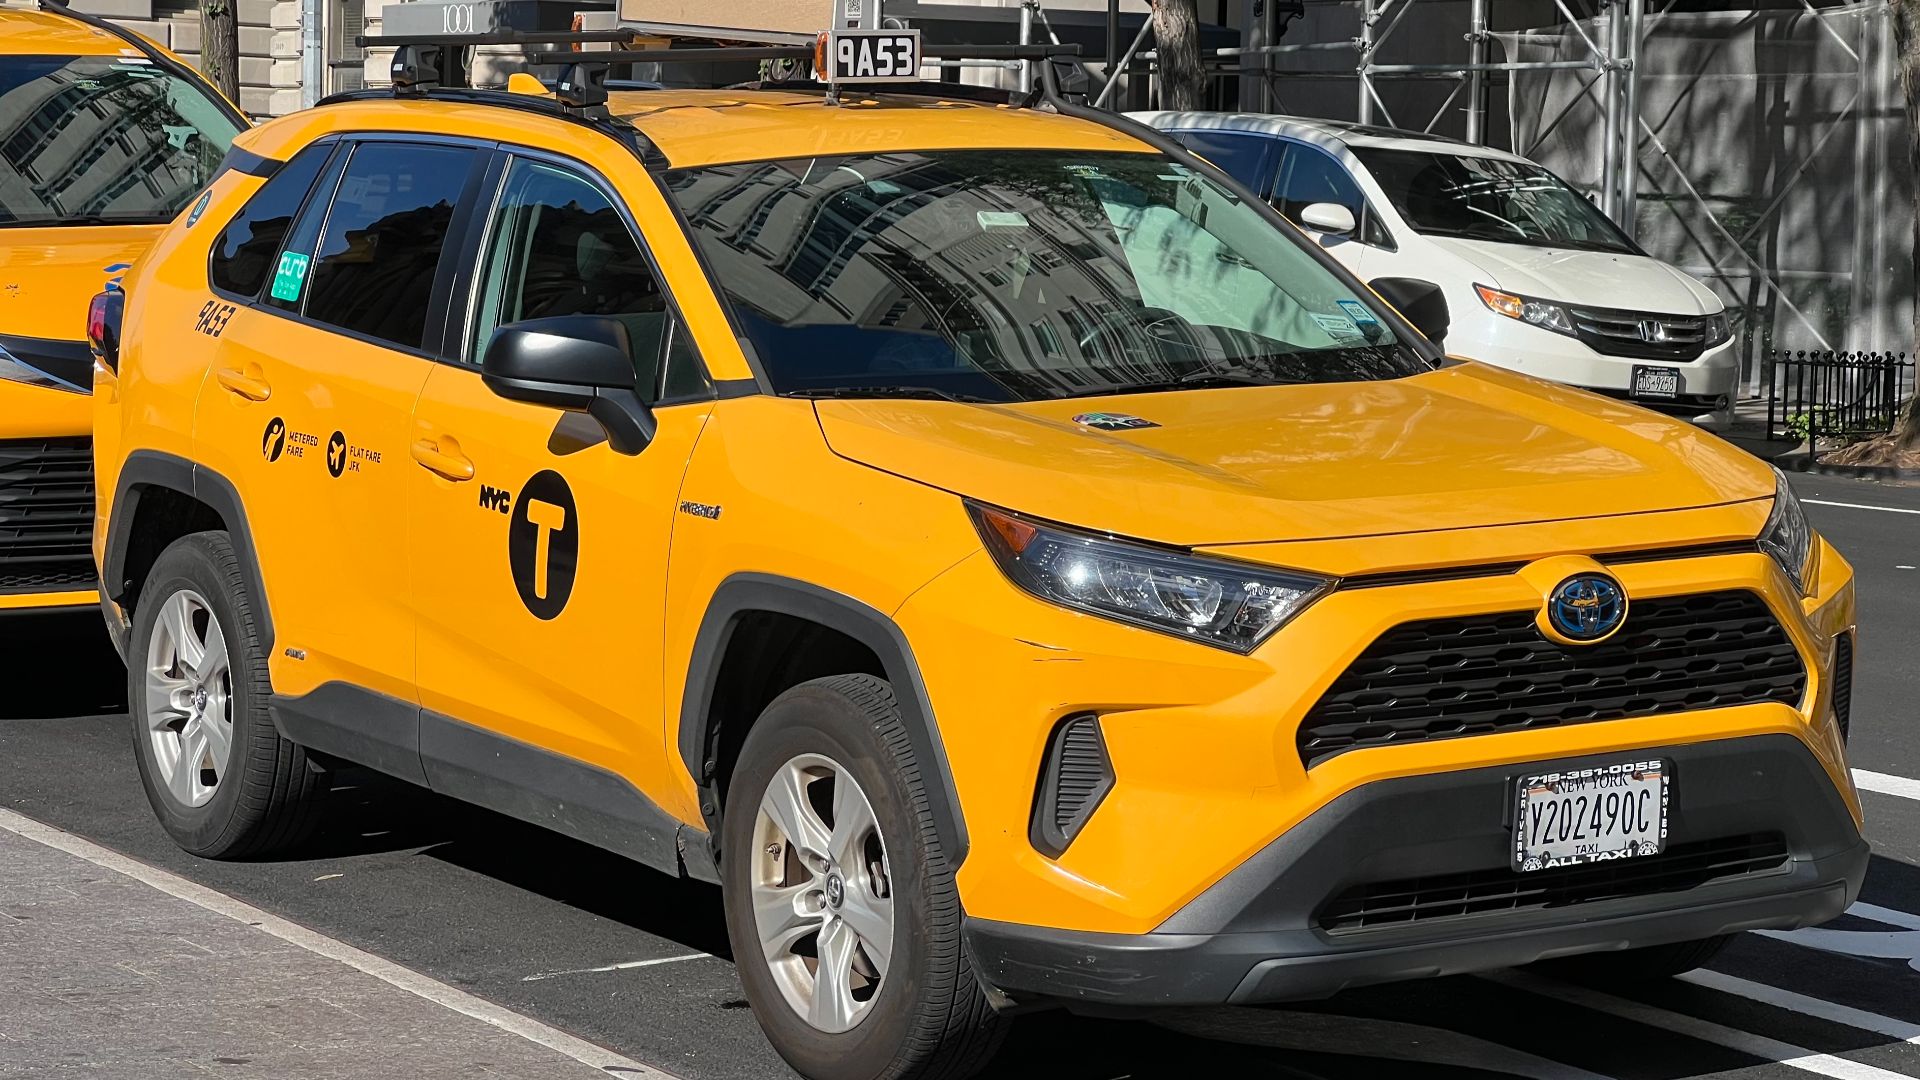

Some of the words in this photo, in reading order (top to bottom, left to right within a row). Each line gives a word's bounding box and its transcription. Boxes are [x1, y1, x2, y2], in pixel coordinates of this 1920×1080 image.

[443, 4, 474, 33] 1001
[838, 37, 913, 77] 9A53
[278, 256, 307, 279] curb
[195, 300, 236, 337] 9A53
[286, 445, 303, 458] FARE
[289, 431, 319, 447] METERED
[349, 461, 361, 472] JFK
[350, 445, 365, 459] FLAT
[366, 450, 382, 464] FARE
[479, 484, 511, 514] NYC
[527, 498, 566, 600] T
[1527, 760, 1661, 786] 718-361-0055
[1557, 776, 1588, 794] NEW
[1592, 773, 1628, 790] YORK
[1531, 788, 1650, 847] Y202490C
[1660, 775, 1670, 839] WANTED
[1516, 788, 1527, 862] DRIVERS
[1545, 854, 1583, 869] ALL
[1585, 849, 1632, 863] TAXI
[1575, 843, 1599, 855] TAXI
